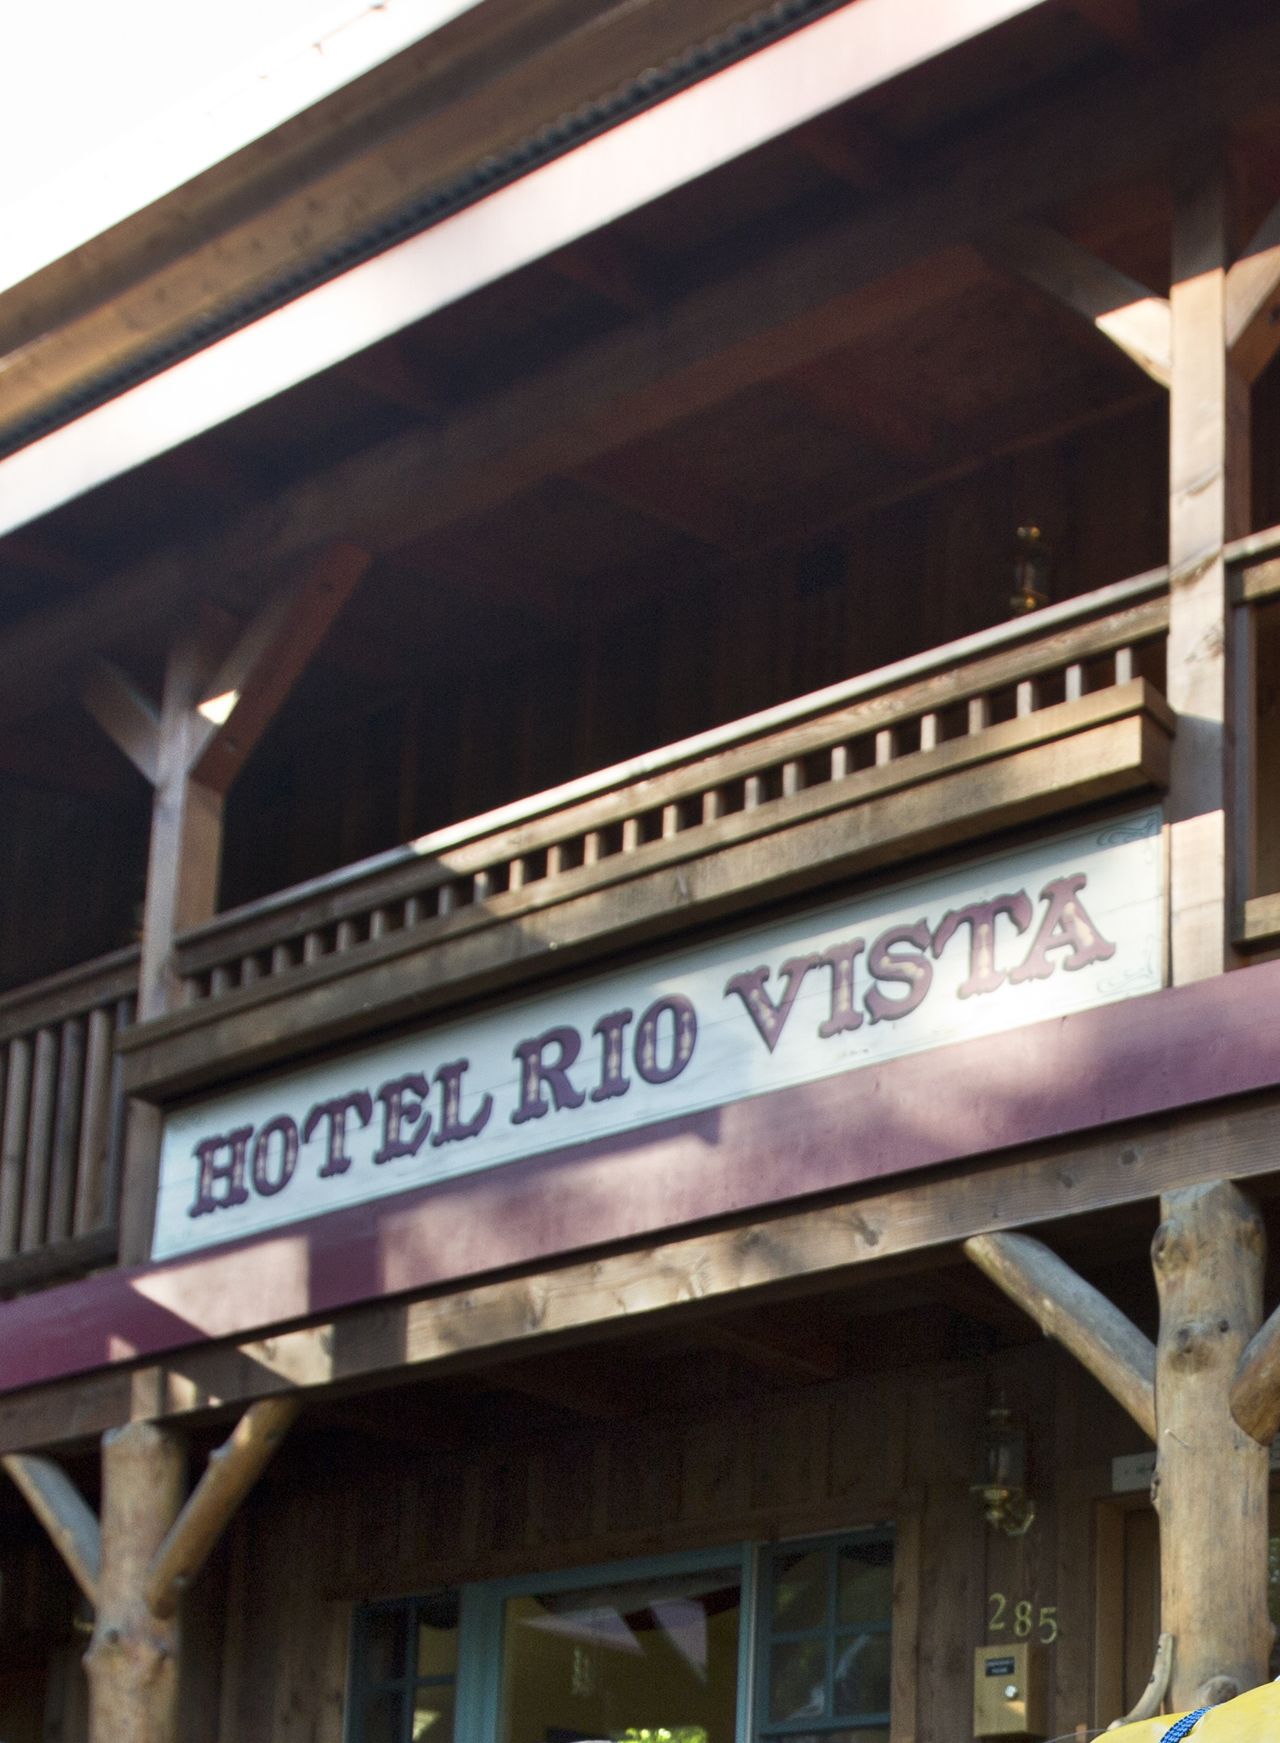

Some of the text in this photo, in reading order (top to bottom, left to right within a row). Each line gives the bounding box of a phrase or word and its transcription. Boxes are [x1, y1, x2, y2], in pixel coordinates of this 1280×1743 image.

[187, 871, 1117, 1219] HOTEL RIO VISTA
[989, 1593, 1059, 1644] 285
